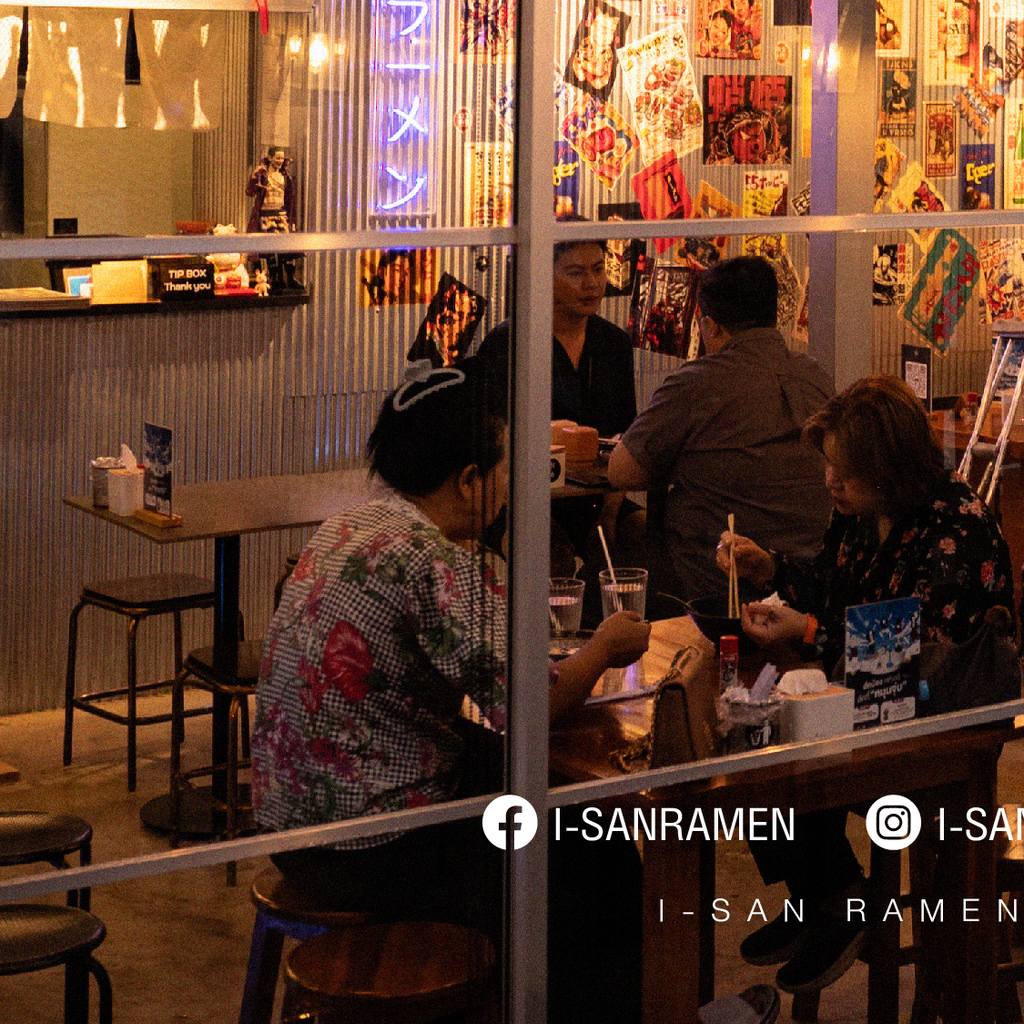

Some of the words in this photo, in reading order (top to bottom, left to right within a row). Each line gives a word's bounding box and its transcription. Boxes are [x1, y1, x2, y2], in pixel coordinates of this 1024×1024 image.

[168, 269, 185, 279] TIP
[186, 268, 207, 279] BOX
[164, 281, 192, 291] Thank
[193, 282, 211, 293] you
